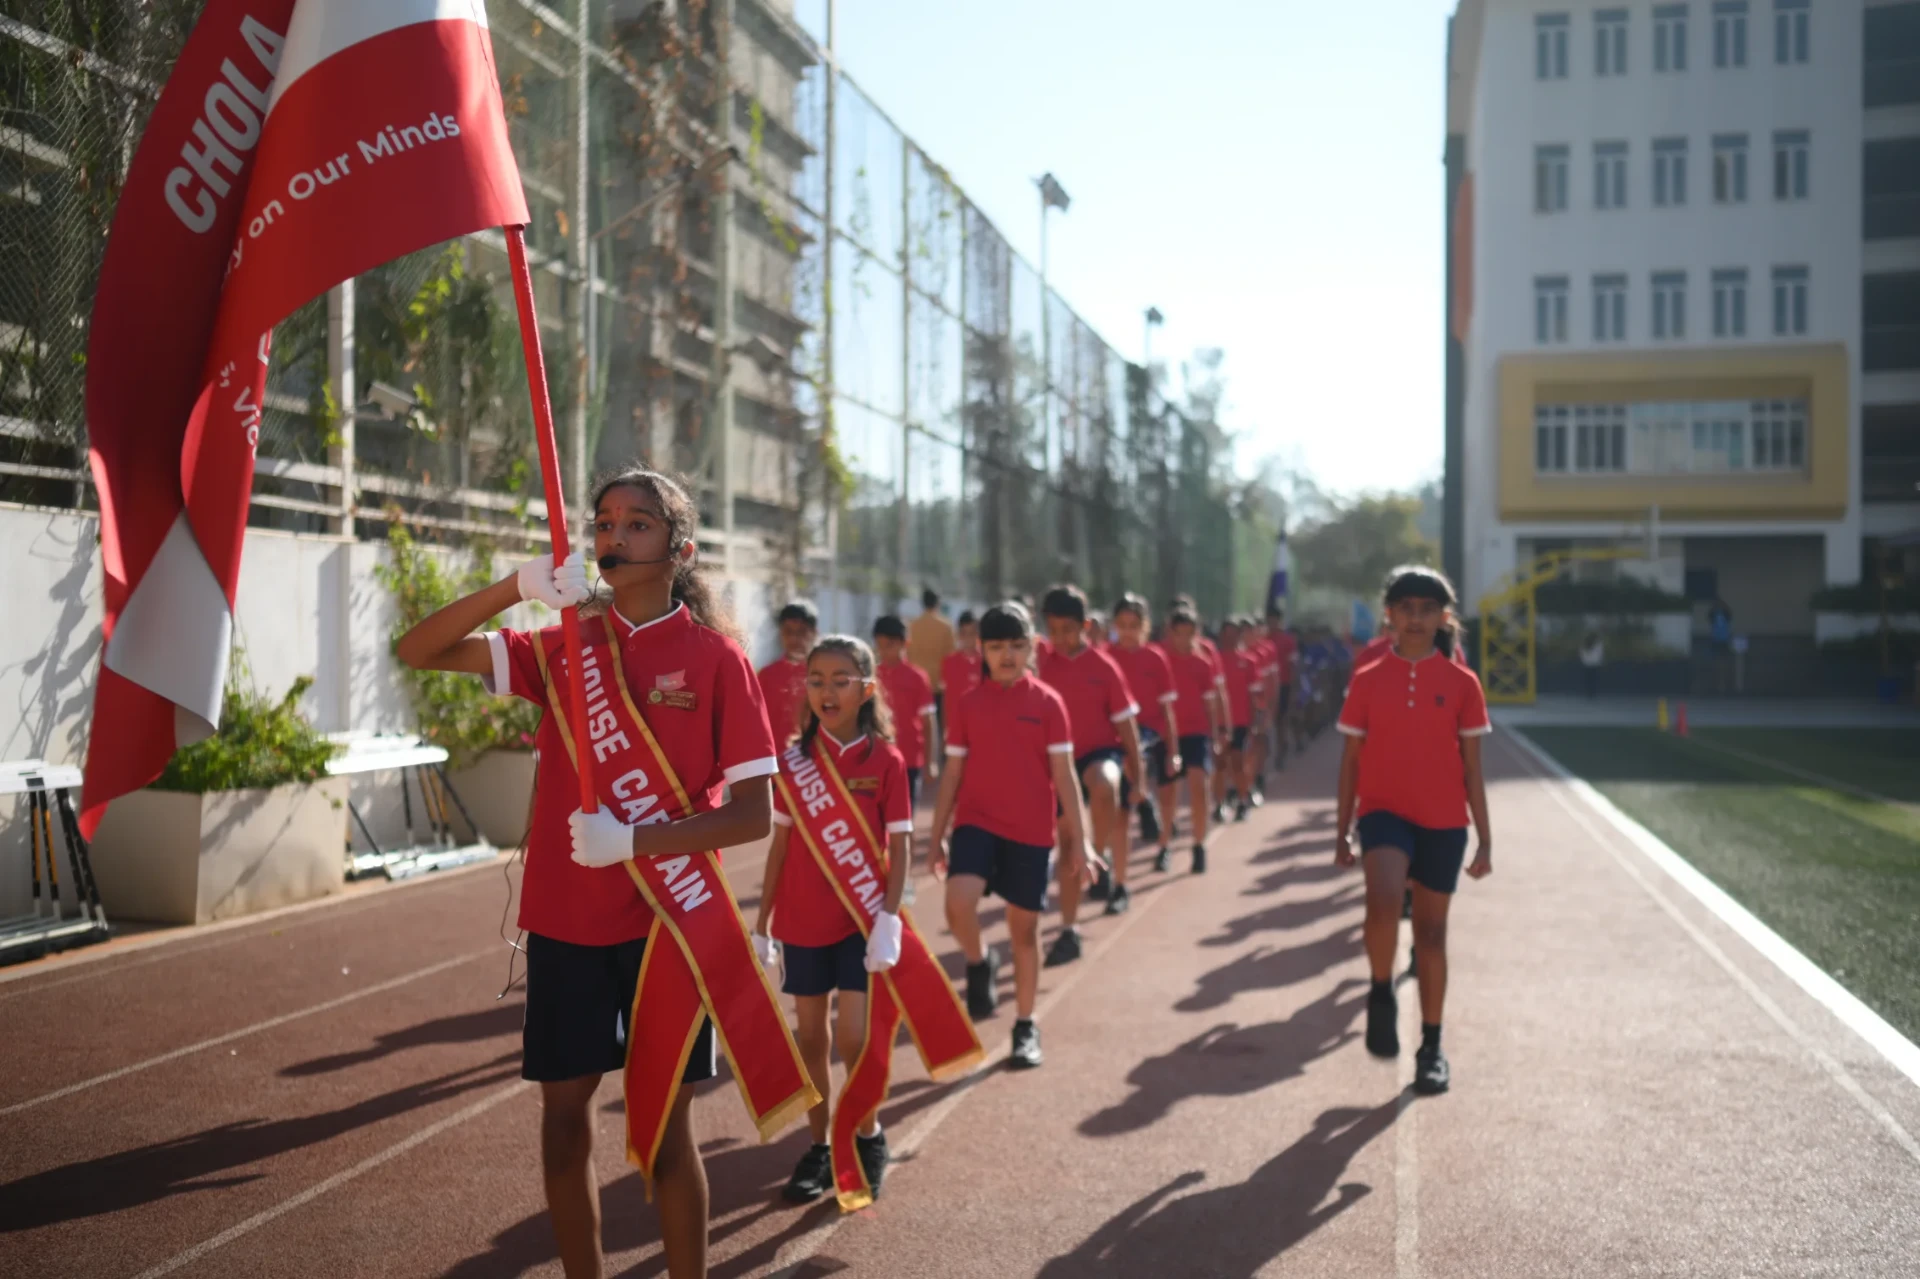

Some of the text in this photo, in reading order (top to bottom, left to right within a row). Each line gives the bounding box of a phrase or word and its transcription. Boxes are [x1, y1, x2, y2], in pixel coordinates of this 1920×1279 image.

[164, 14, 285, 234] CHOLA
[248, 200, 284, 238] on
[288, 153, 351, 200] Our
[356, 111, 460, 165] Minds
